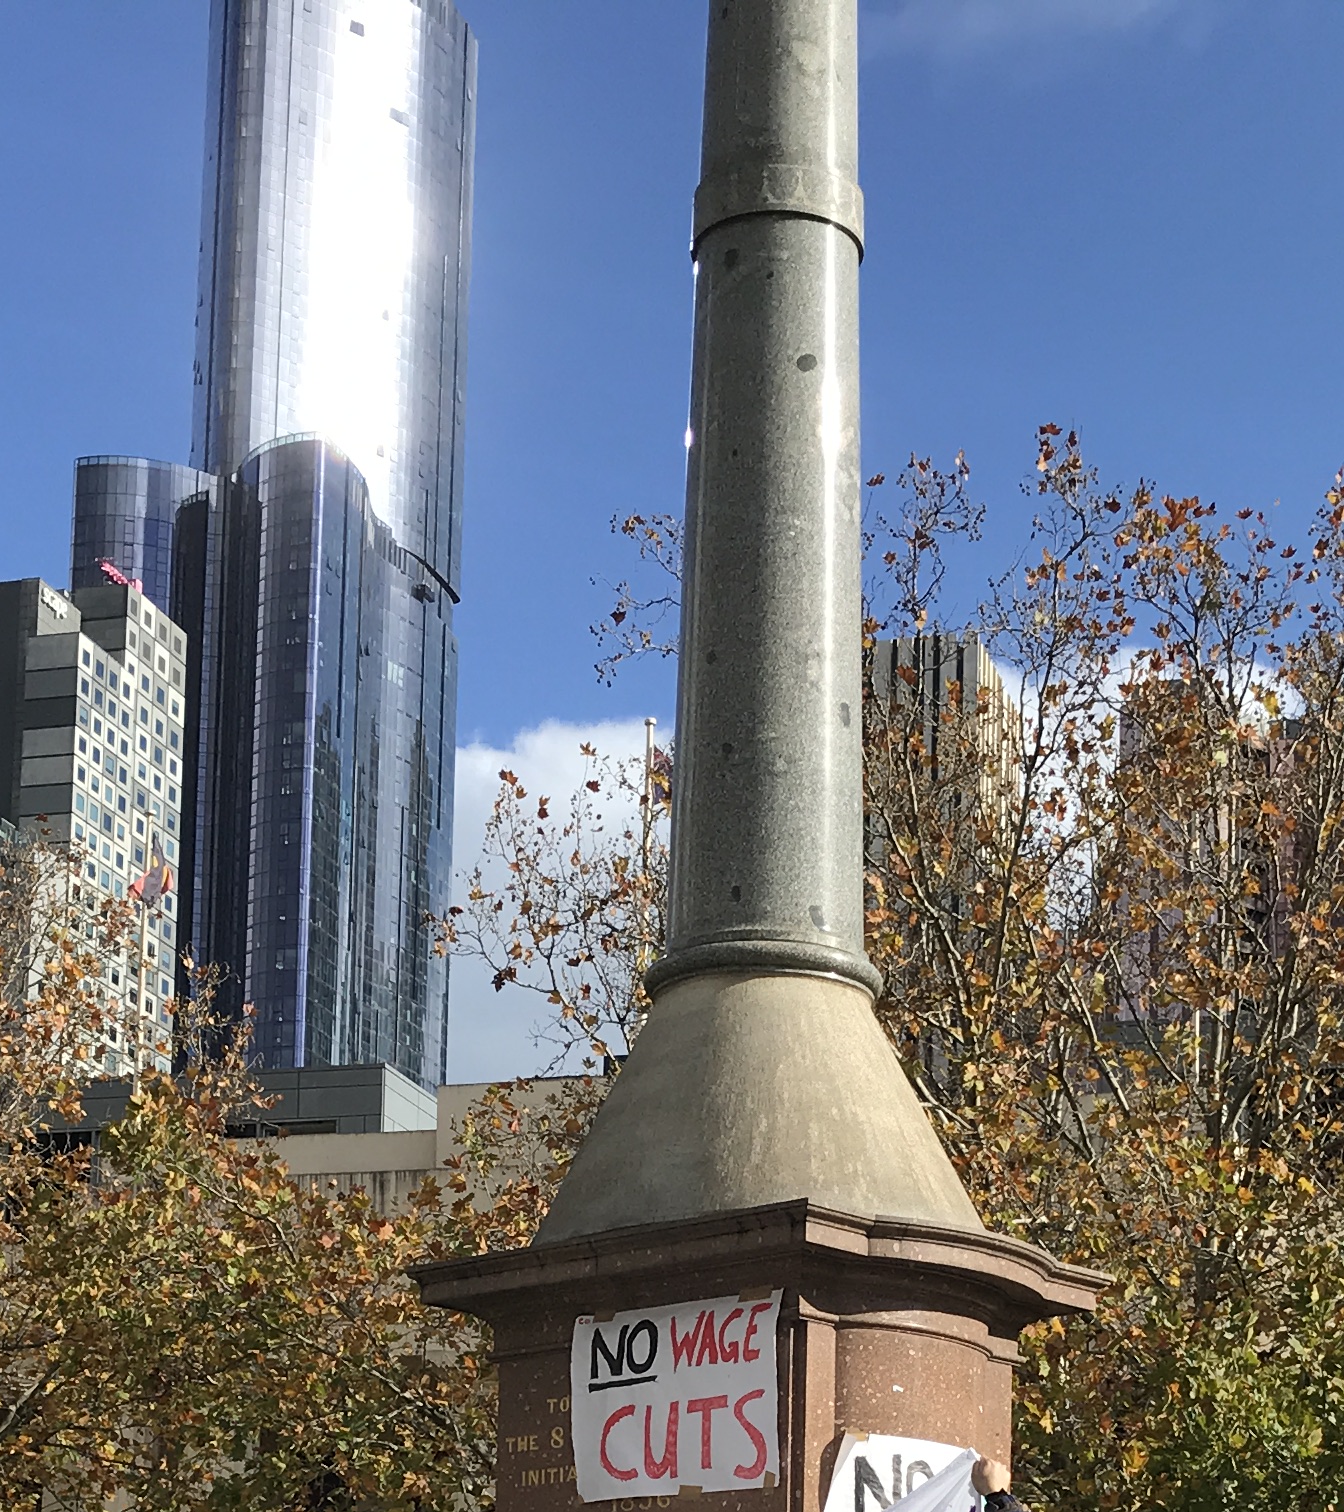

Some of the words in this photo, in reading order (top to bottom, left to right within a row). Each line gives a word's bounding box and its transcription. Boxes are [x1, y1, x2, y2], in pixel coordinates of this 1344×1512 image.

[589, 1319, 656, 1380] NO
[670, 1302, 774, 1373] WAGE
[506, 1435, 539, 1452] THE
[550, 1426, 565, 1449] 8
[599, 1389, 768, 1482] CUTS
